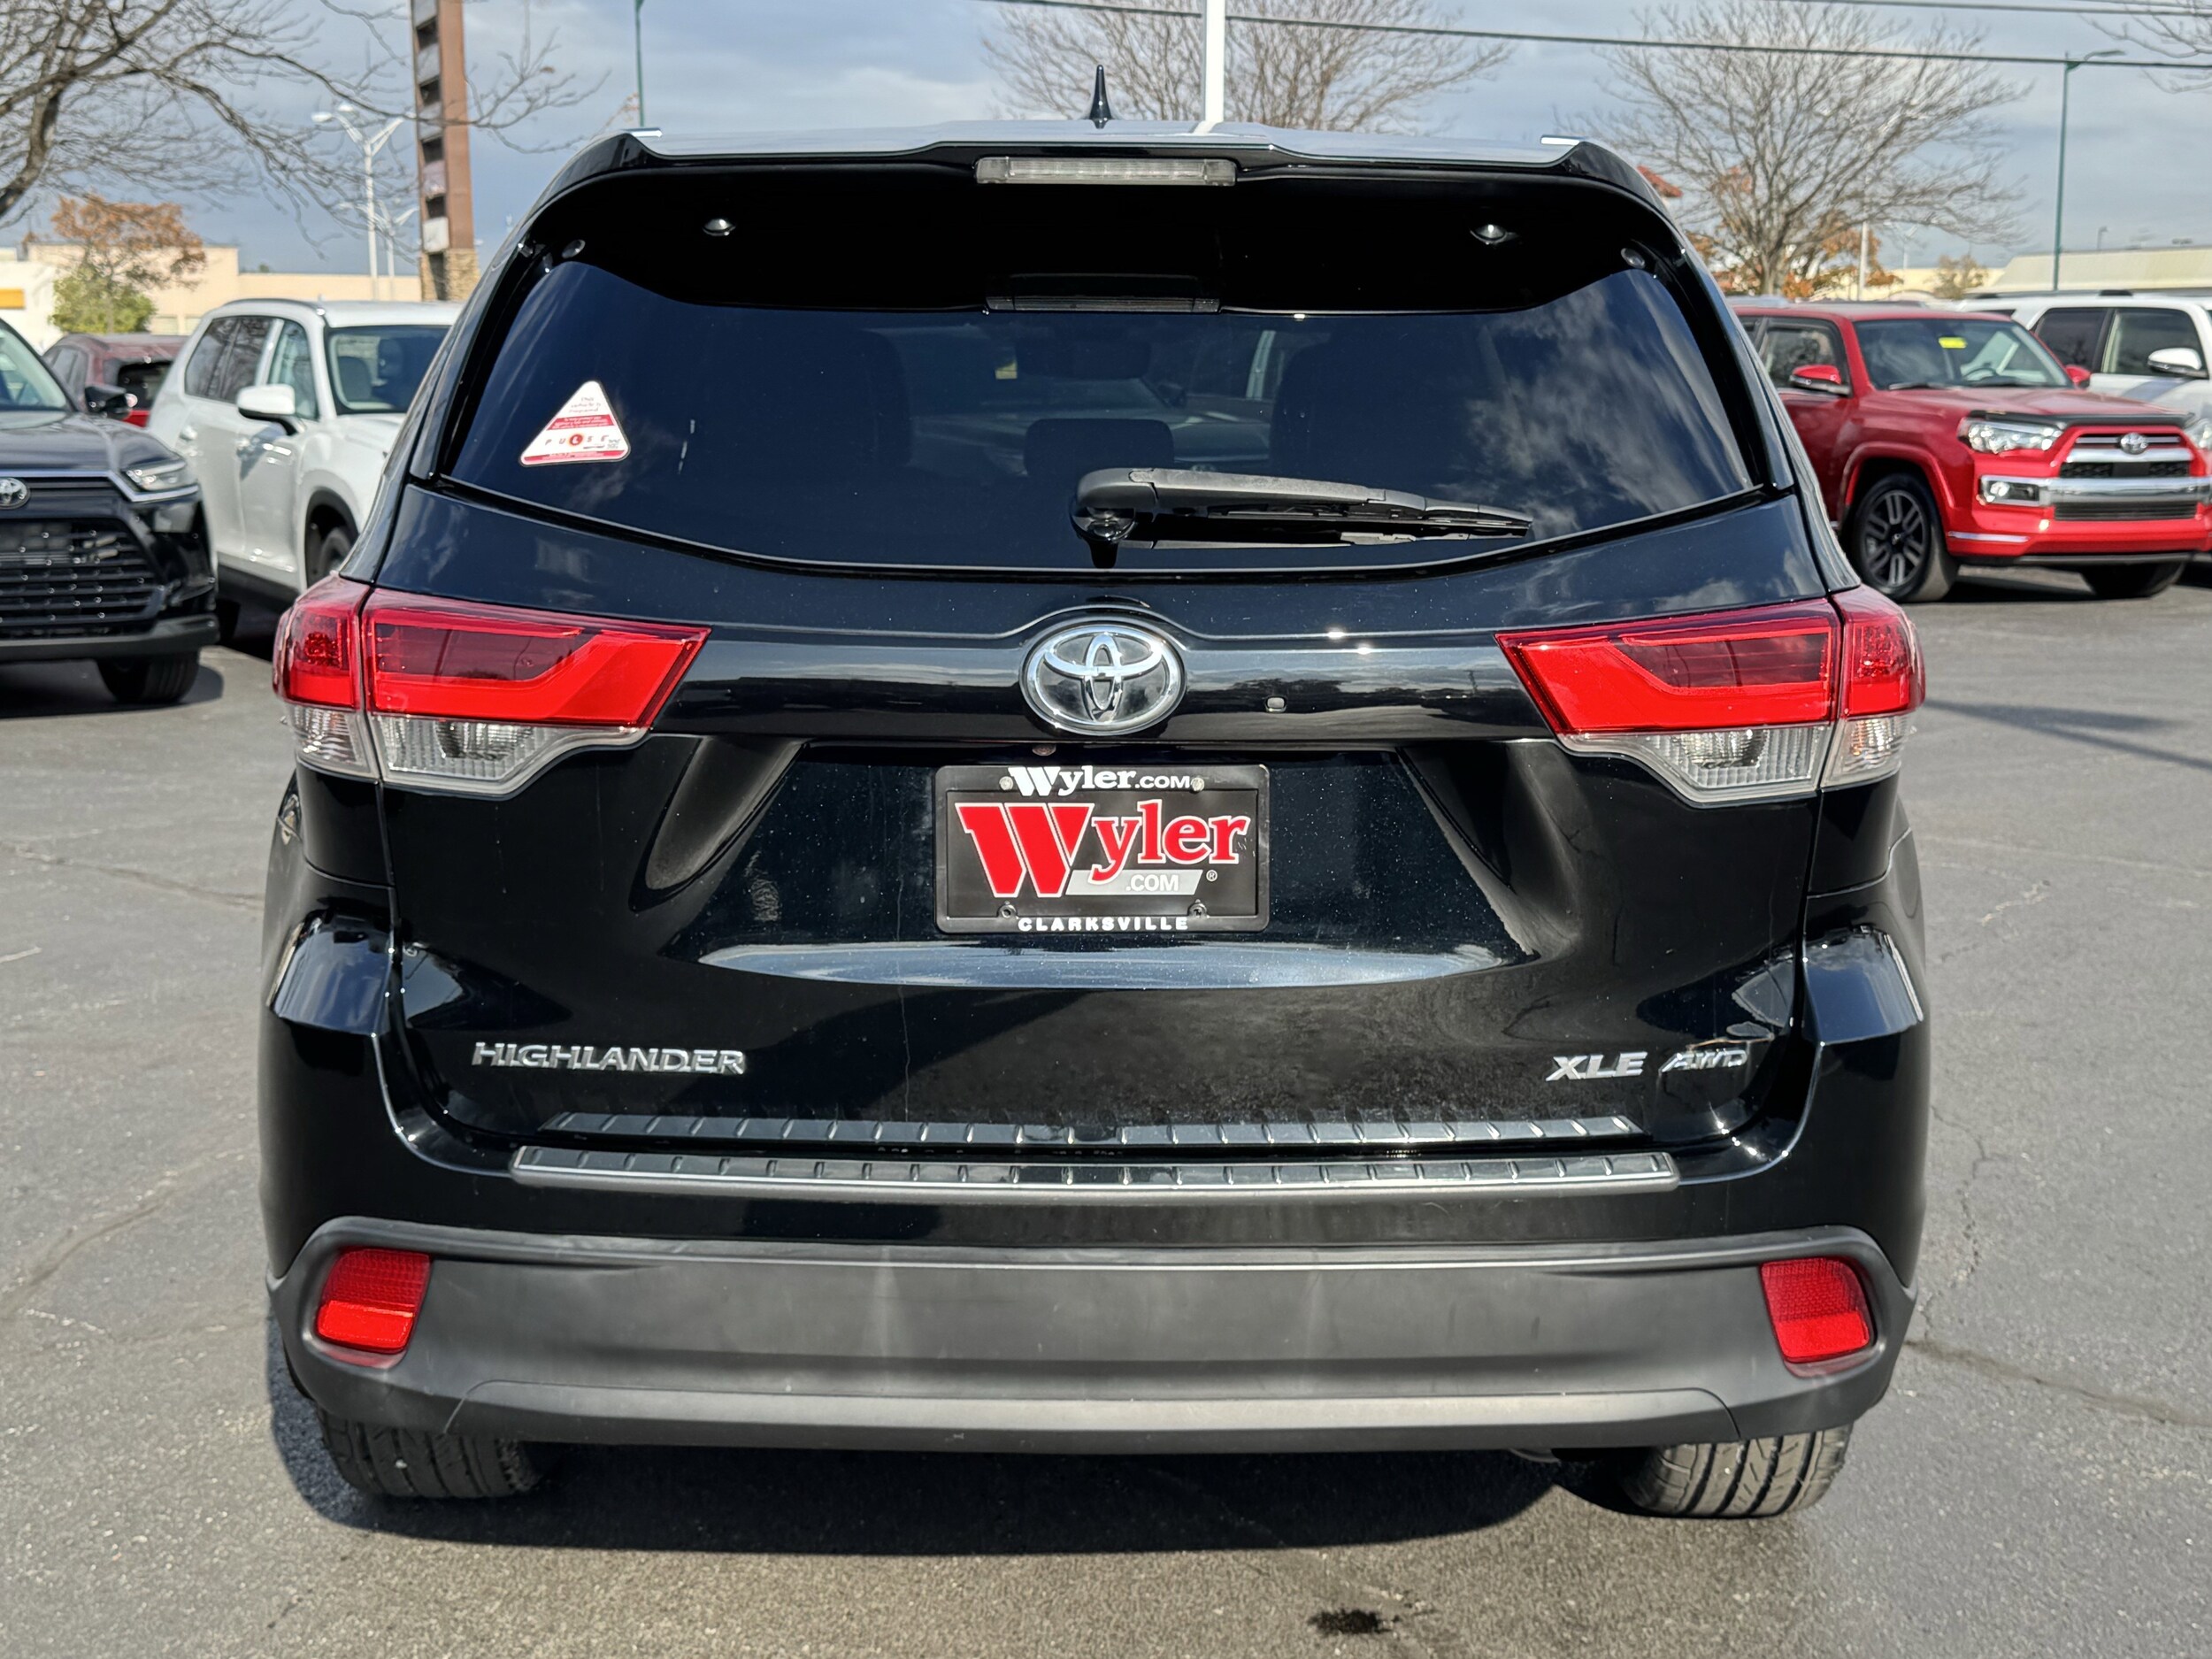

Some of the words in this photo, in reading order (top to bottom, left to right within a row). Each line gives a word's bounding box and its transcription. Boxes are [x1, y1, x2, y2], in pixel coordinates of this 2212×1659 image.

[954, 799, 1252, 898] Wyler
[1018, 917, 1188, 932] CLARKSVILLE
[472, 1041, 746, 1075] HIGHLANDER
[1546, 1051, 1647, 1081] XLE
[1660, 1049, 1747, 1073] AWD
